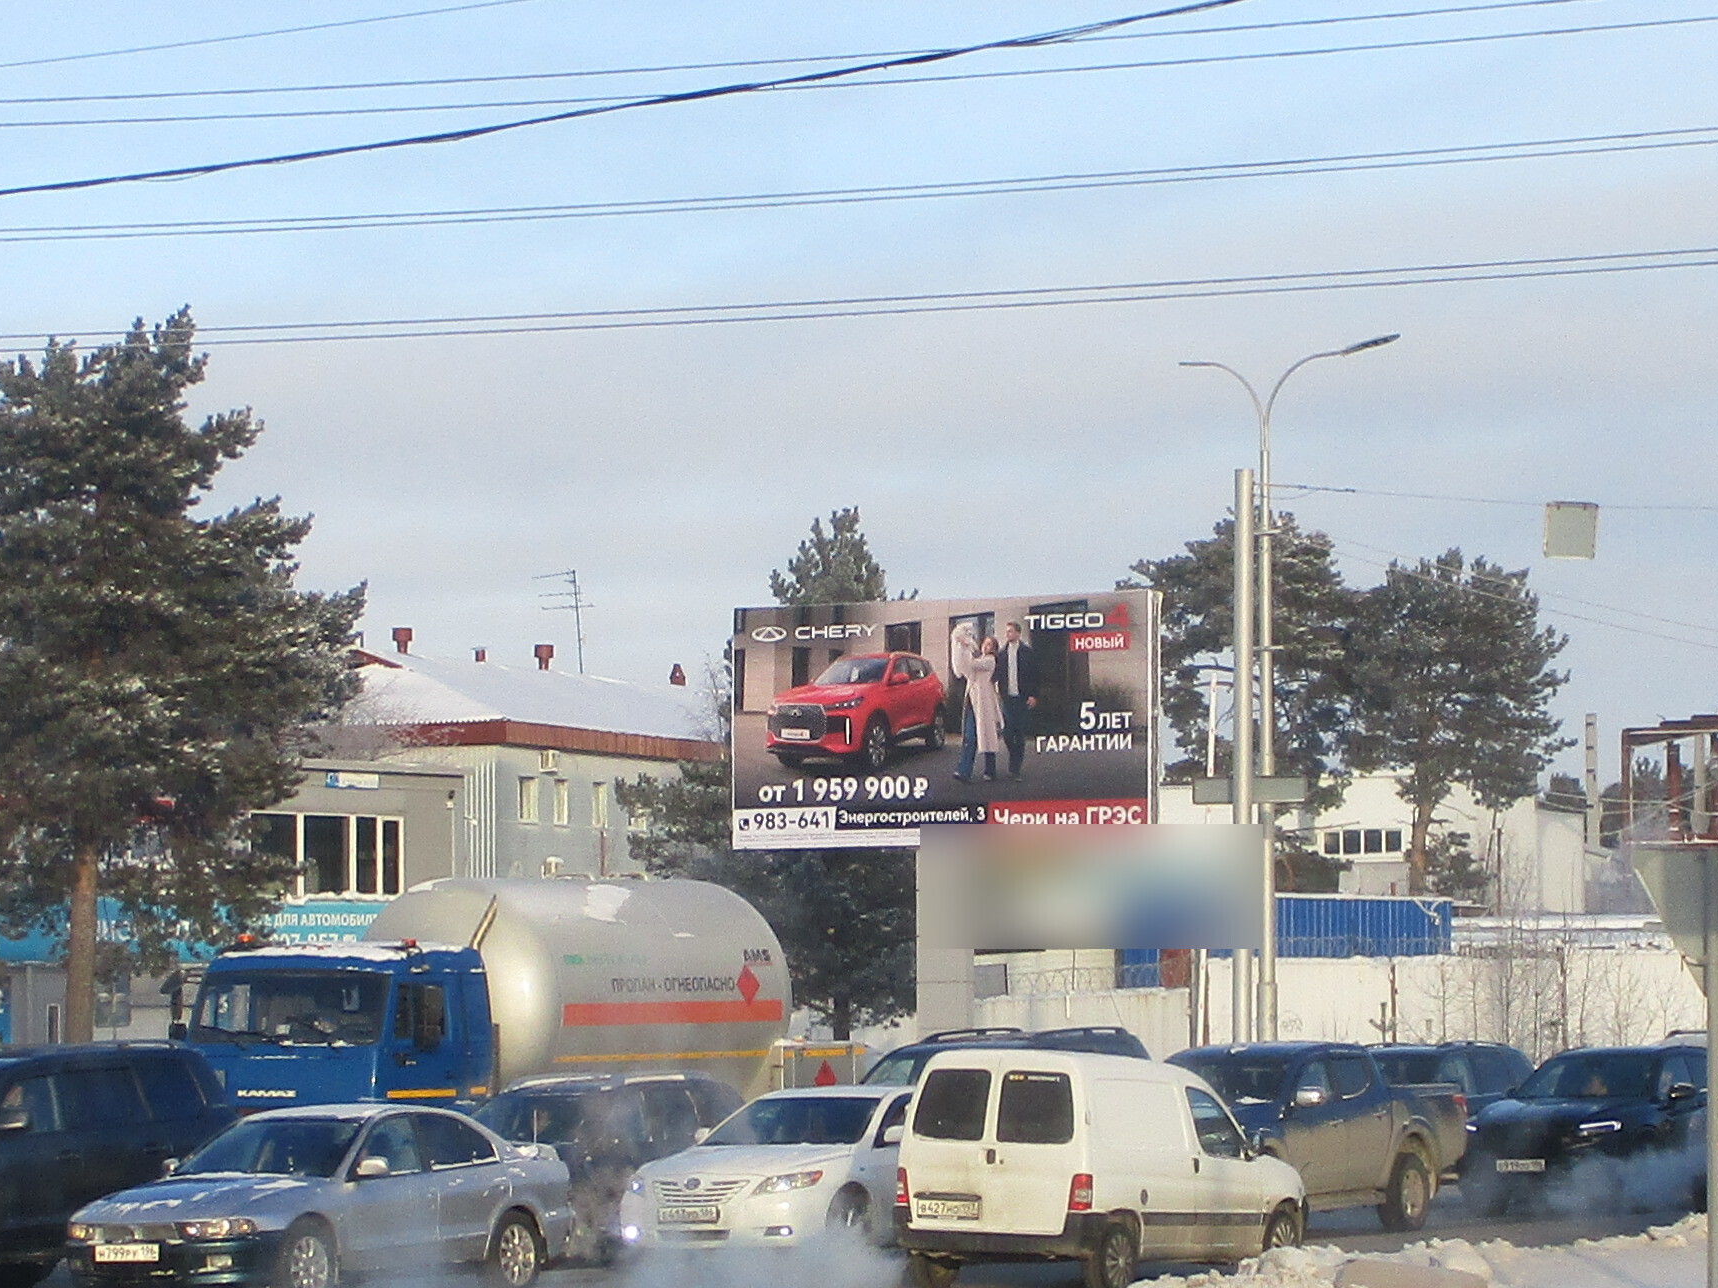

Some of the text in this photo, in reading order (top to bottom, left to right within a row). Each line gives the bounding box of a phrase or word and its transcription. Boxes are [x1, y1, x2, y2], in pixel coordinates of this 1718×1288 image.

[1024, 603, 1131, 630] TIGGO 4
[794, 623, 878, 640] CHERY
[1075, 633, 1125, 650] НОВЫЙ
[1035, 733, 1133, 753] ГАРАНТИИ
[758, 785, 786, 803] от
[791, 778, 806, 802] 1
[812, 777, 859, 802] 959
[753, 811, 831, 831] 983-641
[838, 806, 986, 827] Энергостроителей, 3
[994, 805, 1142, 825] Чери на ГРЭС
[273, 913, 299, 928] ДЛЯ
[664, 976, 735, 992] ОГНЕОПАСНО
